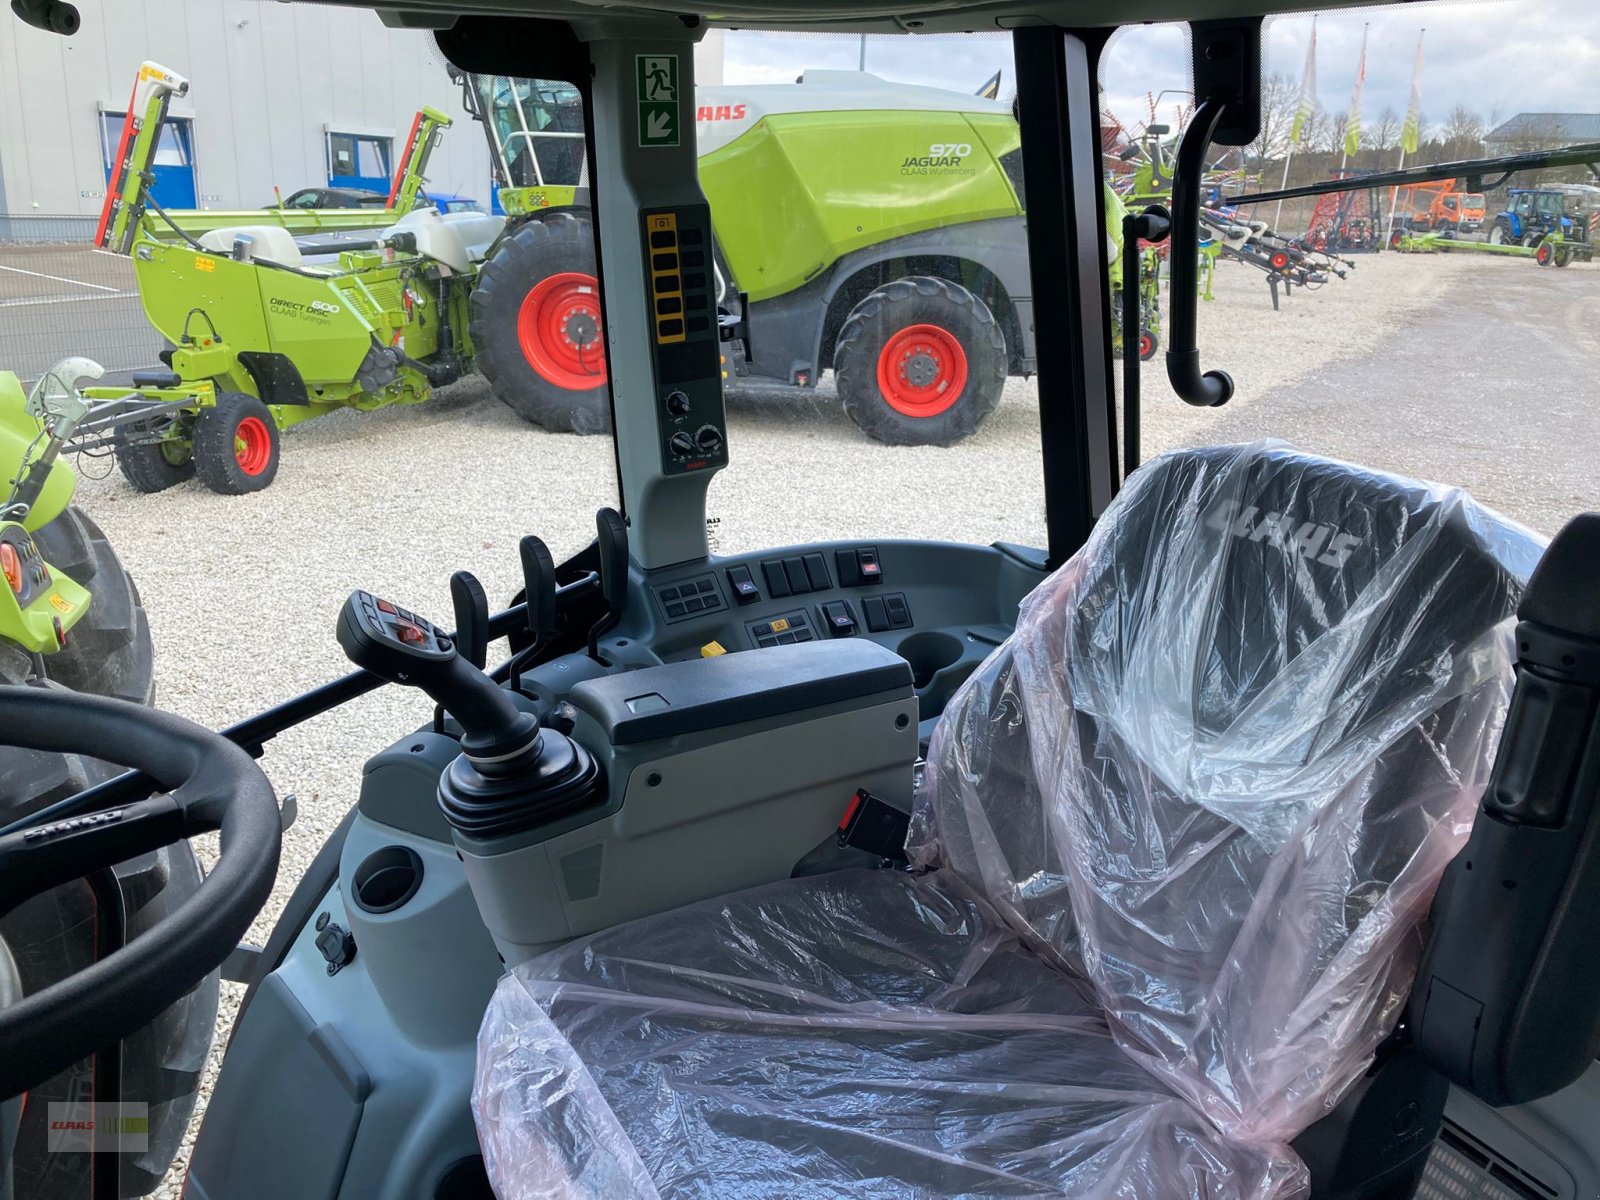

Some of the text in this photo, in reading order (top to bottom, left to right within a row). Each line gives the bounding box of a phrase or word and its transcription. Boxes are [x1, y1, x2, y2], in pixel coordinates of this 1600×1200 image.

[696, 104, 746, 122] AAS
[929, 143, 972, 158] 970
[901, 156, 962, 168] JAGUAR
[900, 167, 928, 176] CLAAS
[269, 297, 329, 318] DIRECT DISC
[270, 306, 297, 318] CLAAS
[1204, 499, 1364, 569] CLAAS
